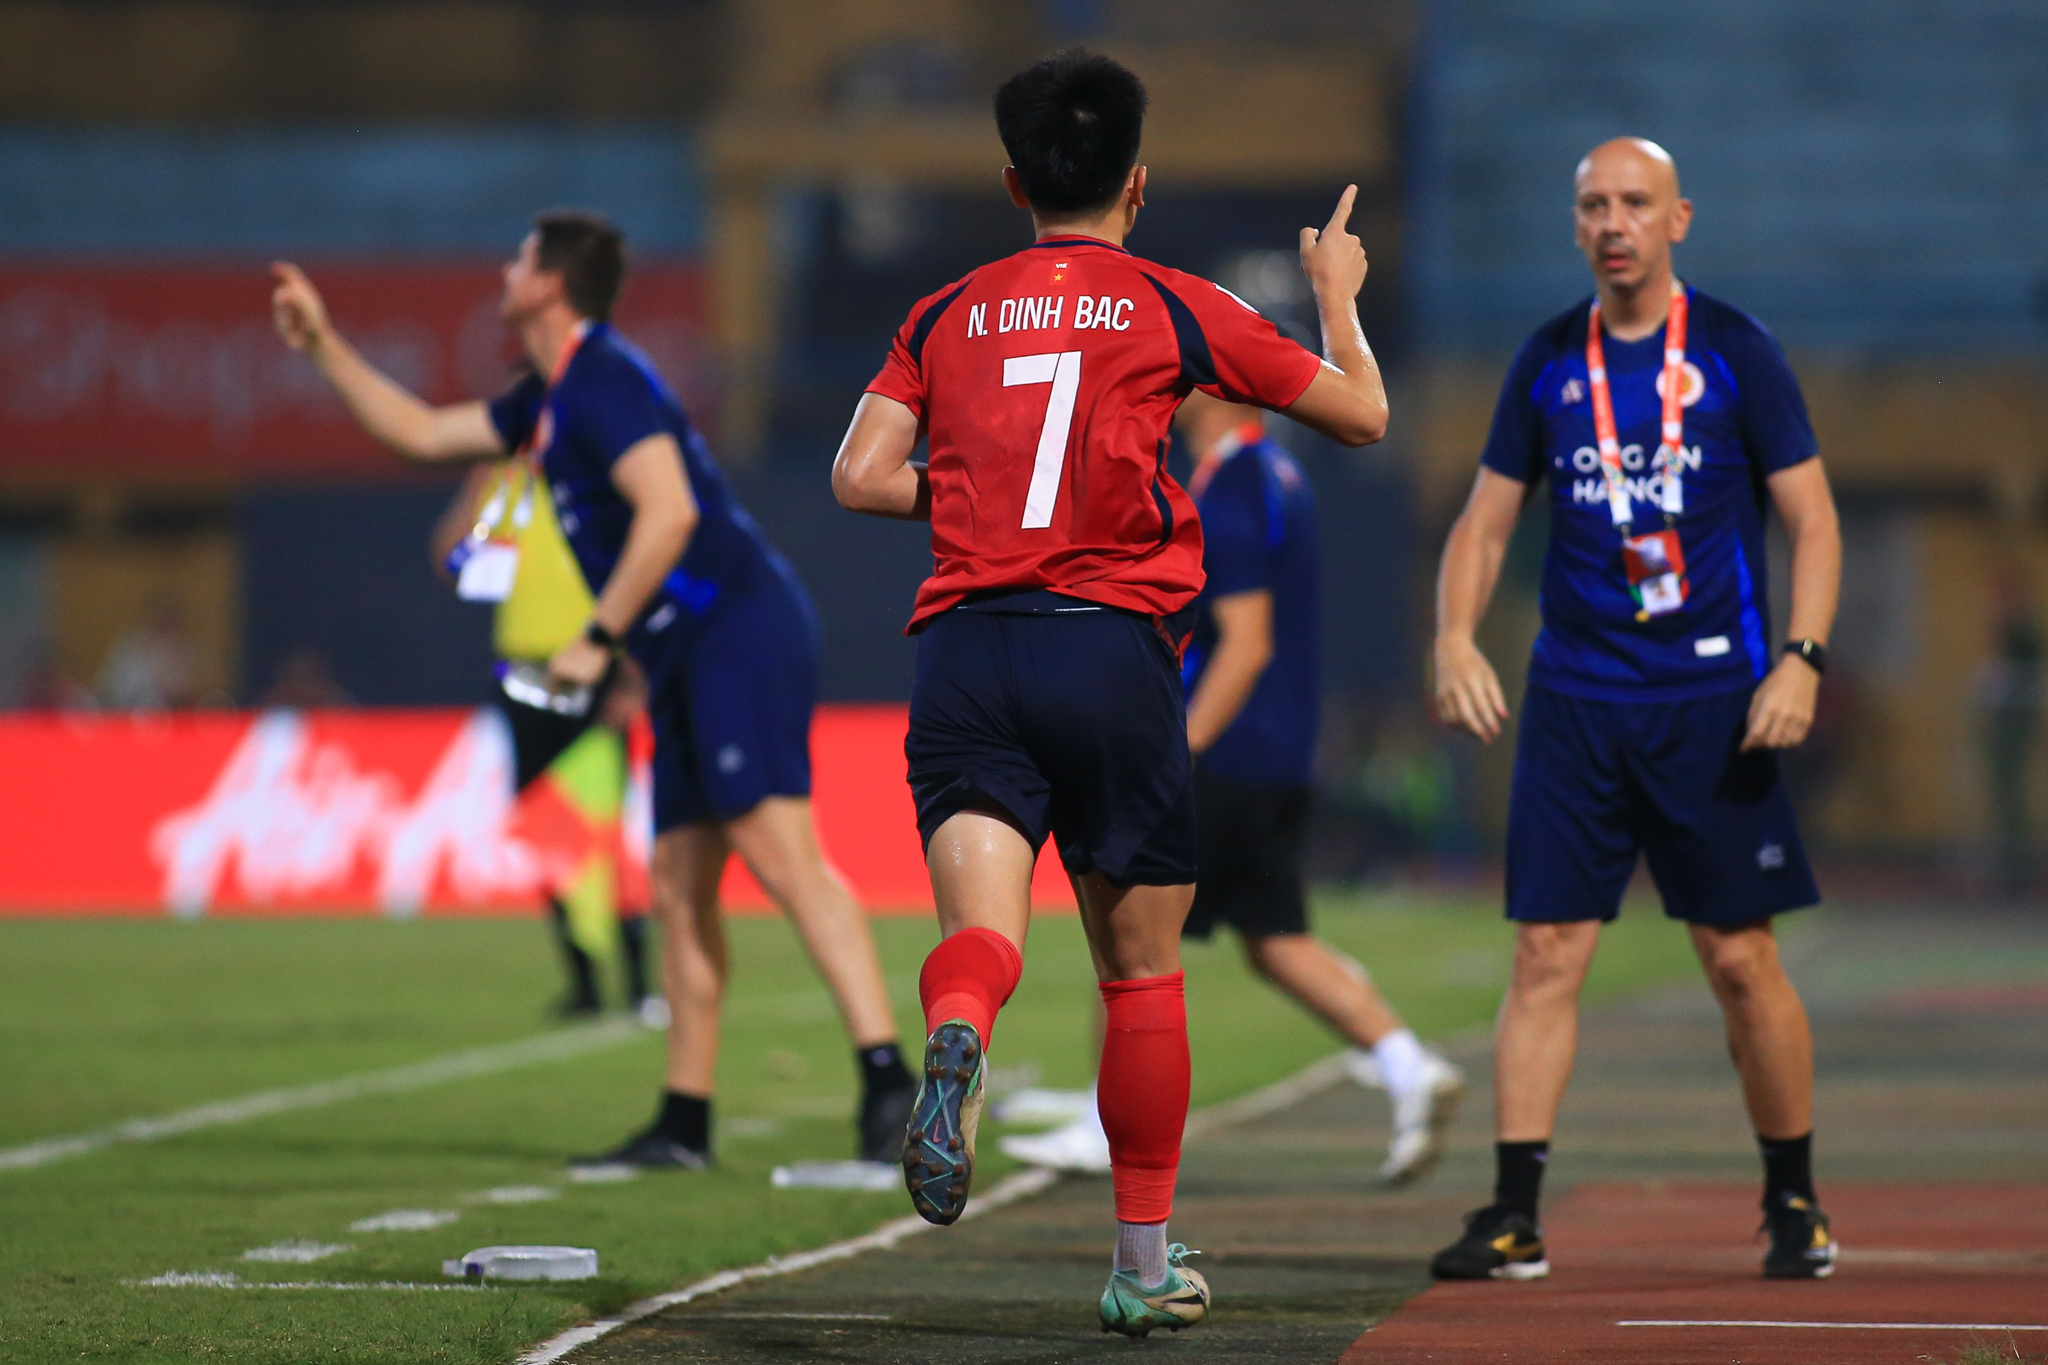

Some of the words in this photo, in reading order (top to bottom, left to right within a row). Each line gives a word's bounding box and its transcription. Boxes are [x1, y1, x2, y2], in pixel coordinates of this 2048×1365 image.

[967, 302, 989, 339] N.
[998, 295, 1064, 334] DINH
[1073, 295, 1135, 332] BAC
[1002, 350, 1082, 530] 7
